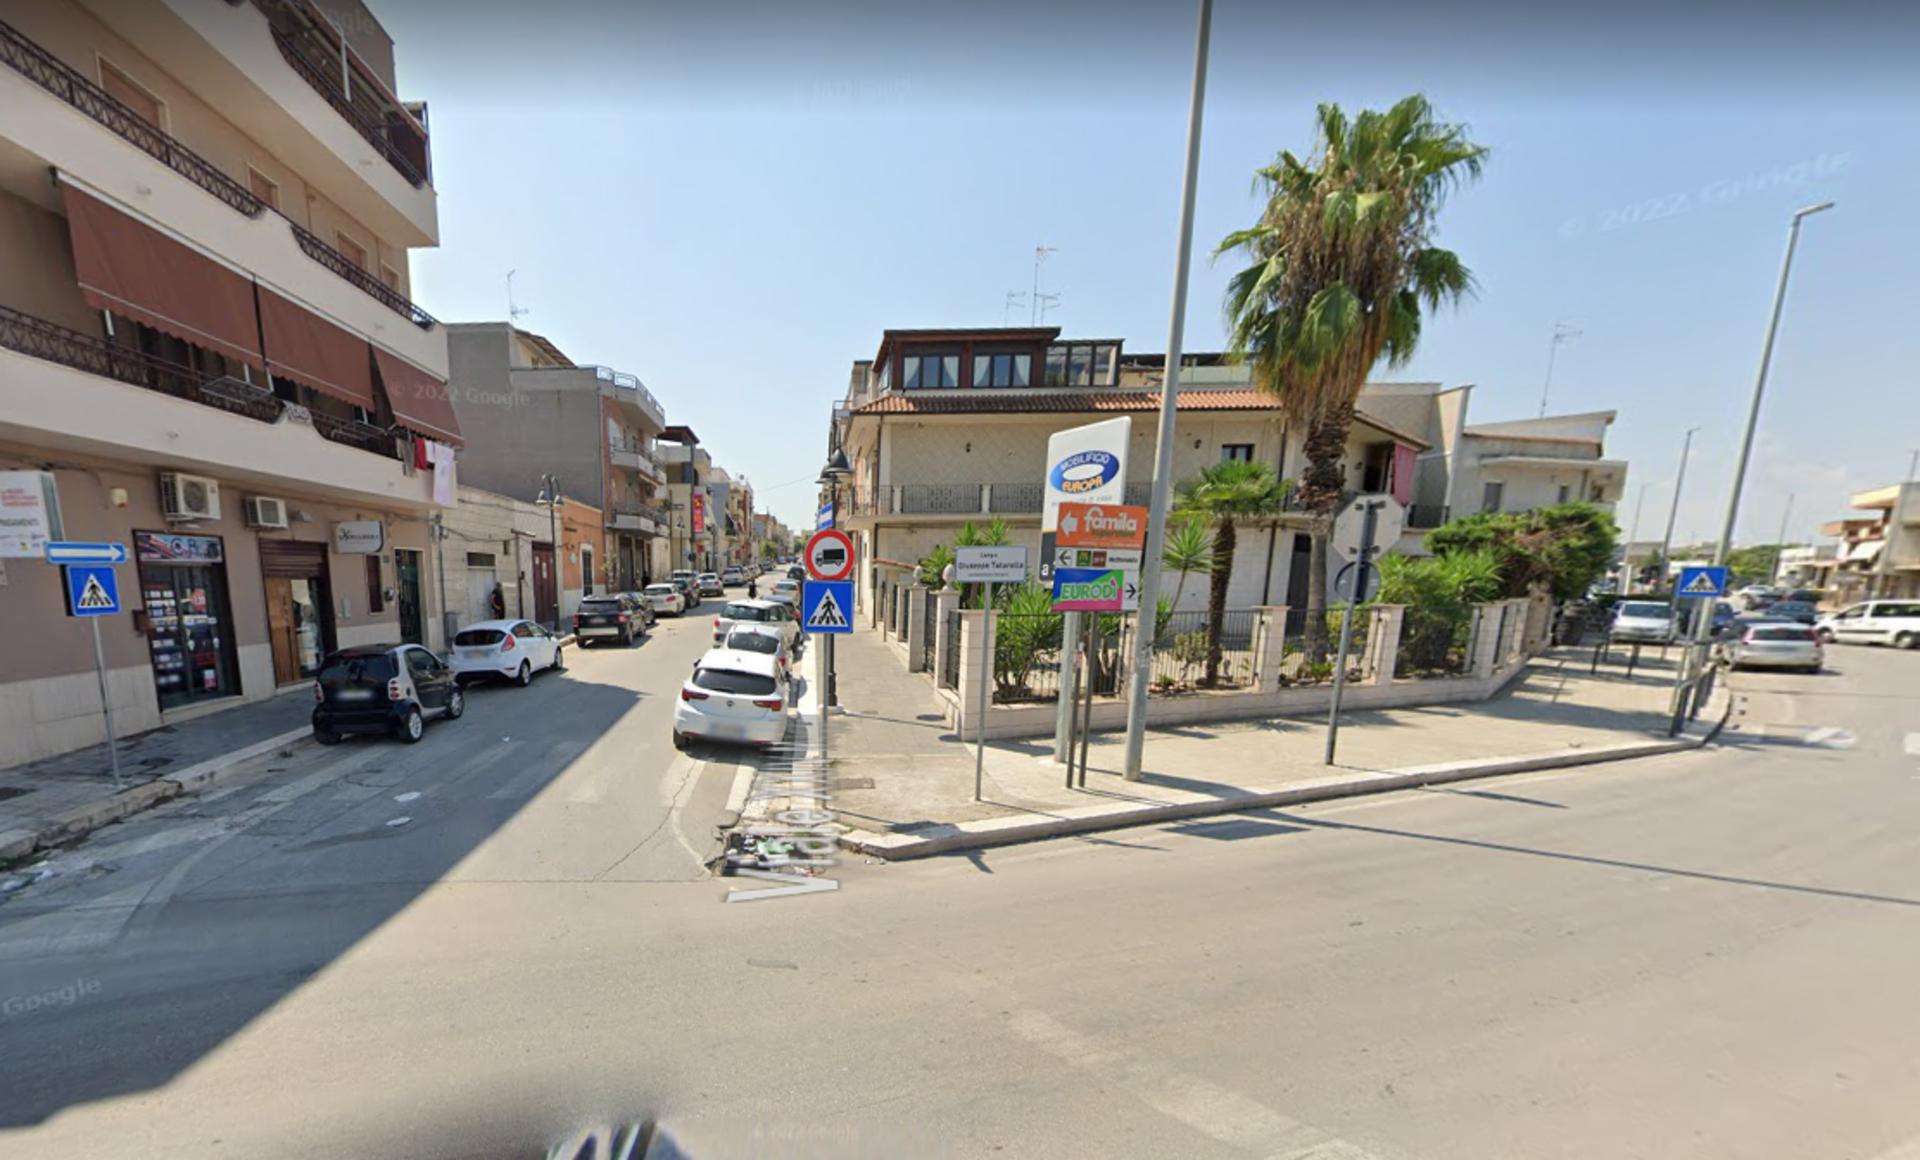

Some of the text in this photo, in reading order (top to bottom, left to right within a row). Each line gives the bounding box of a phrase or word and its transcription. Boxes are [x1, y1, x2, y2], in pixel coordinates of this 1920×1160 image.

[1062, 475, 1104, 494] EUROPA
[1084, 505, 1137, 533] famila
[958, 561, 990, 571] Giuseppe
